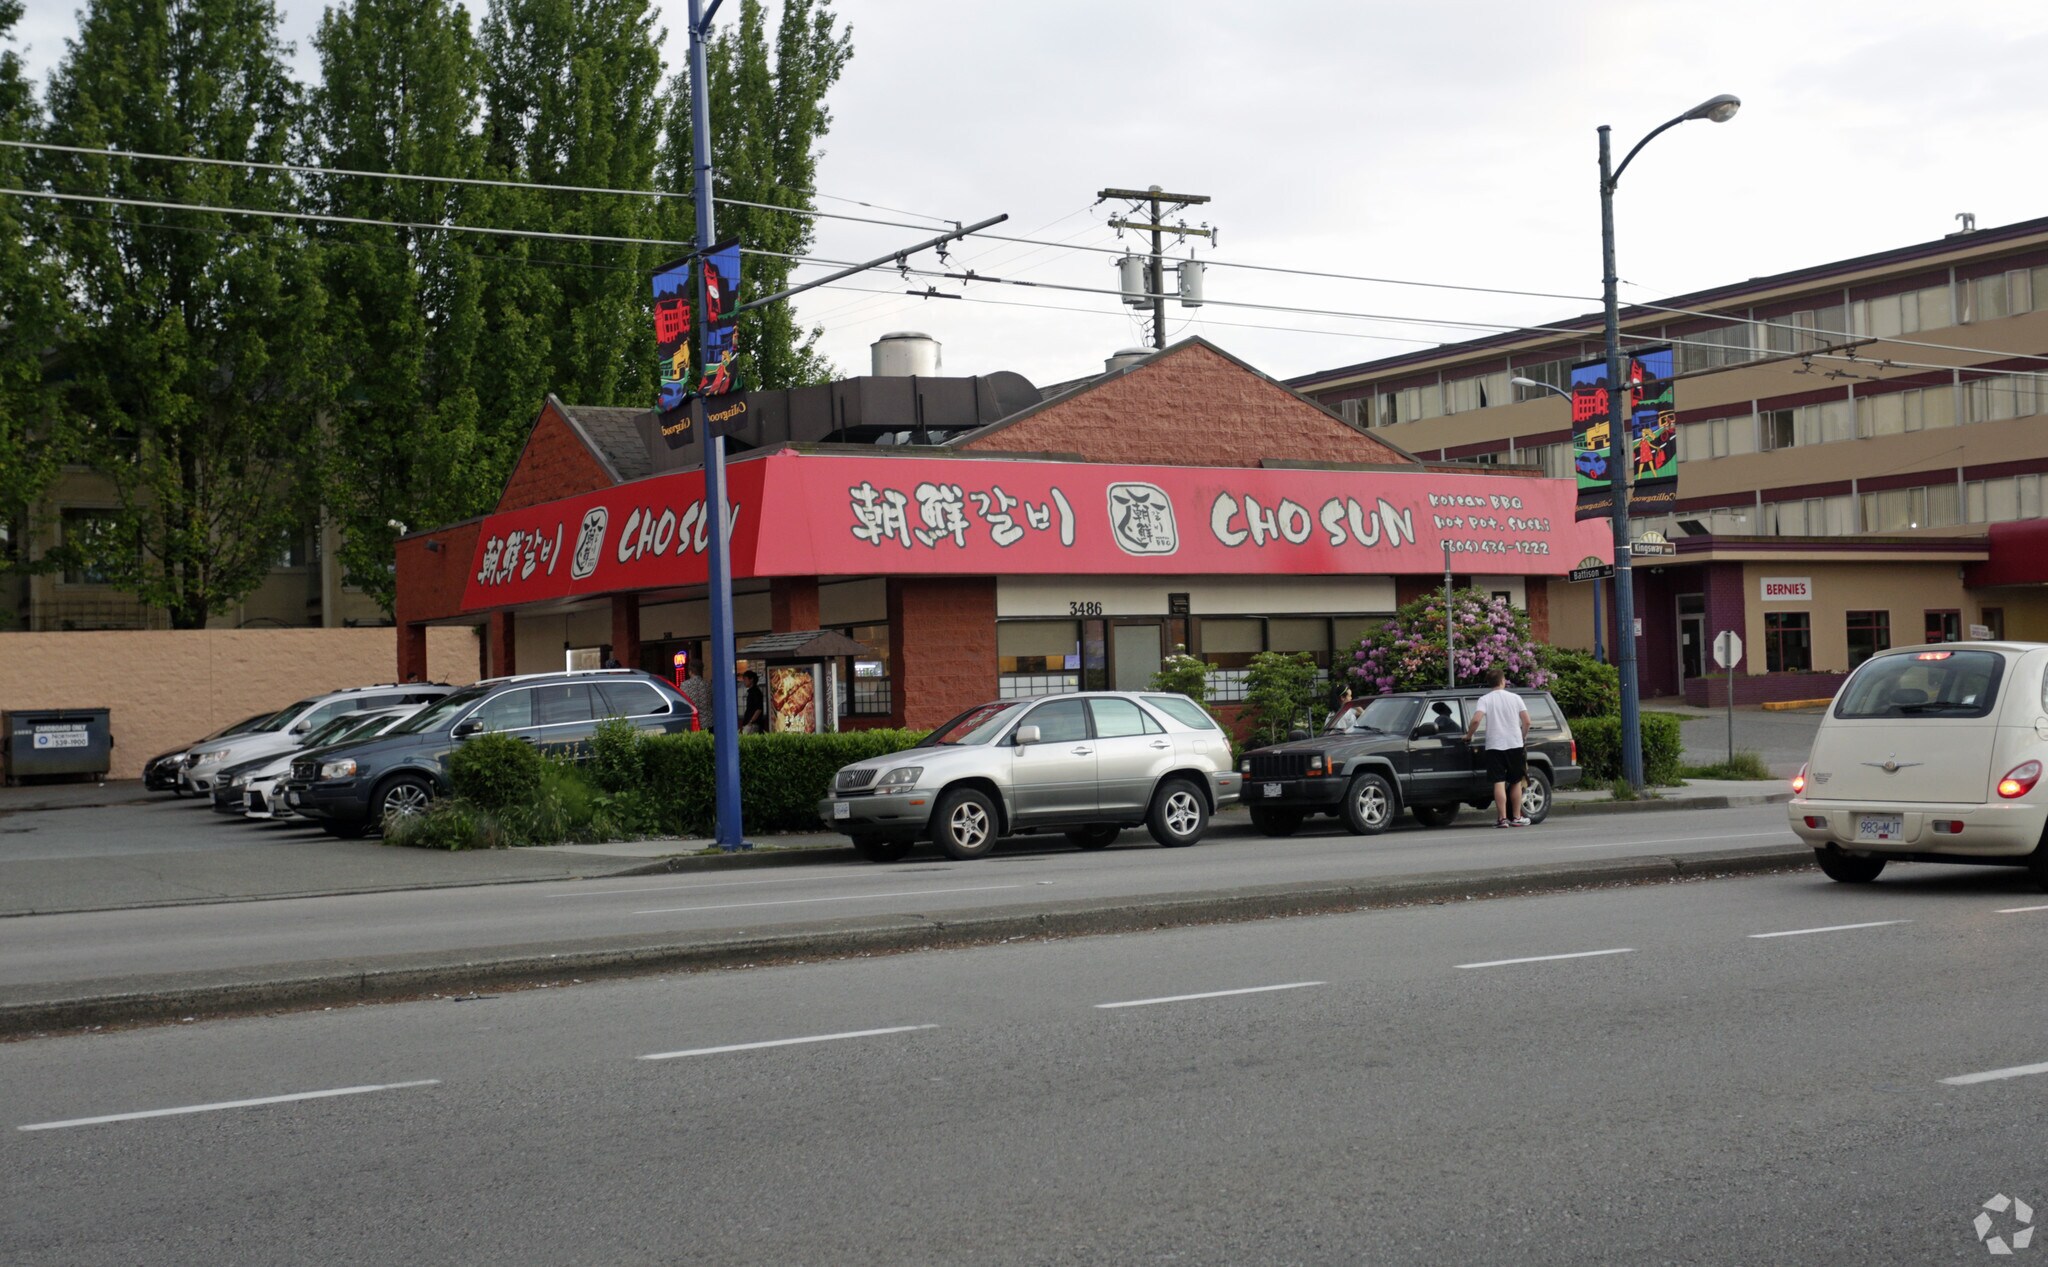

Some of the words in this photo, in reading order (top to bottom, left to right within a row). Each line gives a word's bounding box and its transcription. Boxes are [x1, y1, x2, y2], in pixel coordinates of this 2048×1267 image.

[1427, 492, 1486, 508] Korean
[1488, 494, 1523, 510] BBQ
[1210, 490, 1312, 547] CHO
[1318, 496, 1415, 547] SUN
[1433, 514, 1464, 529] Hot
[1507, 516, 1550, 532] Sushi
[617, 505, 677, 564] CHO
[1634, 543, 1663, 555] Kingsway
[1573, 569, 1600, 580] Battison
[1766, 583, 1806, 595] BERNIE'S
[1069, 601, 1103, 616] 3486
